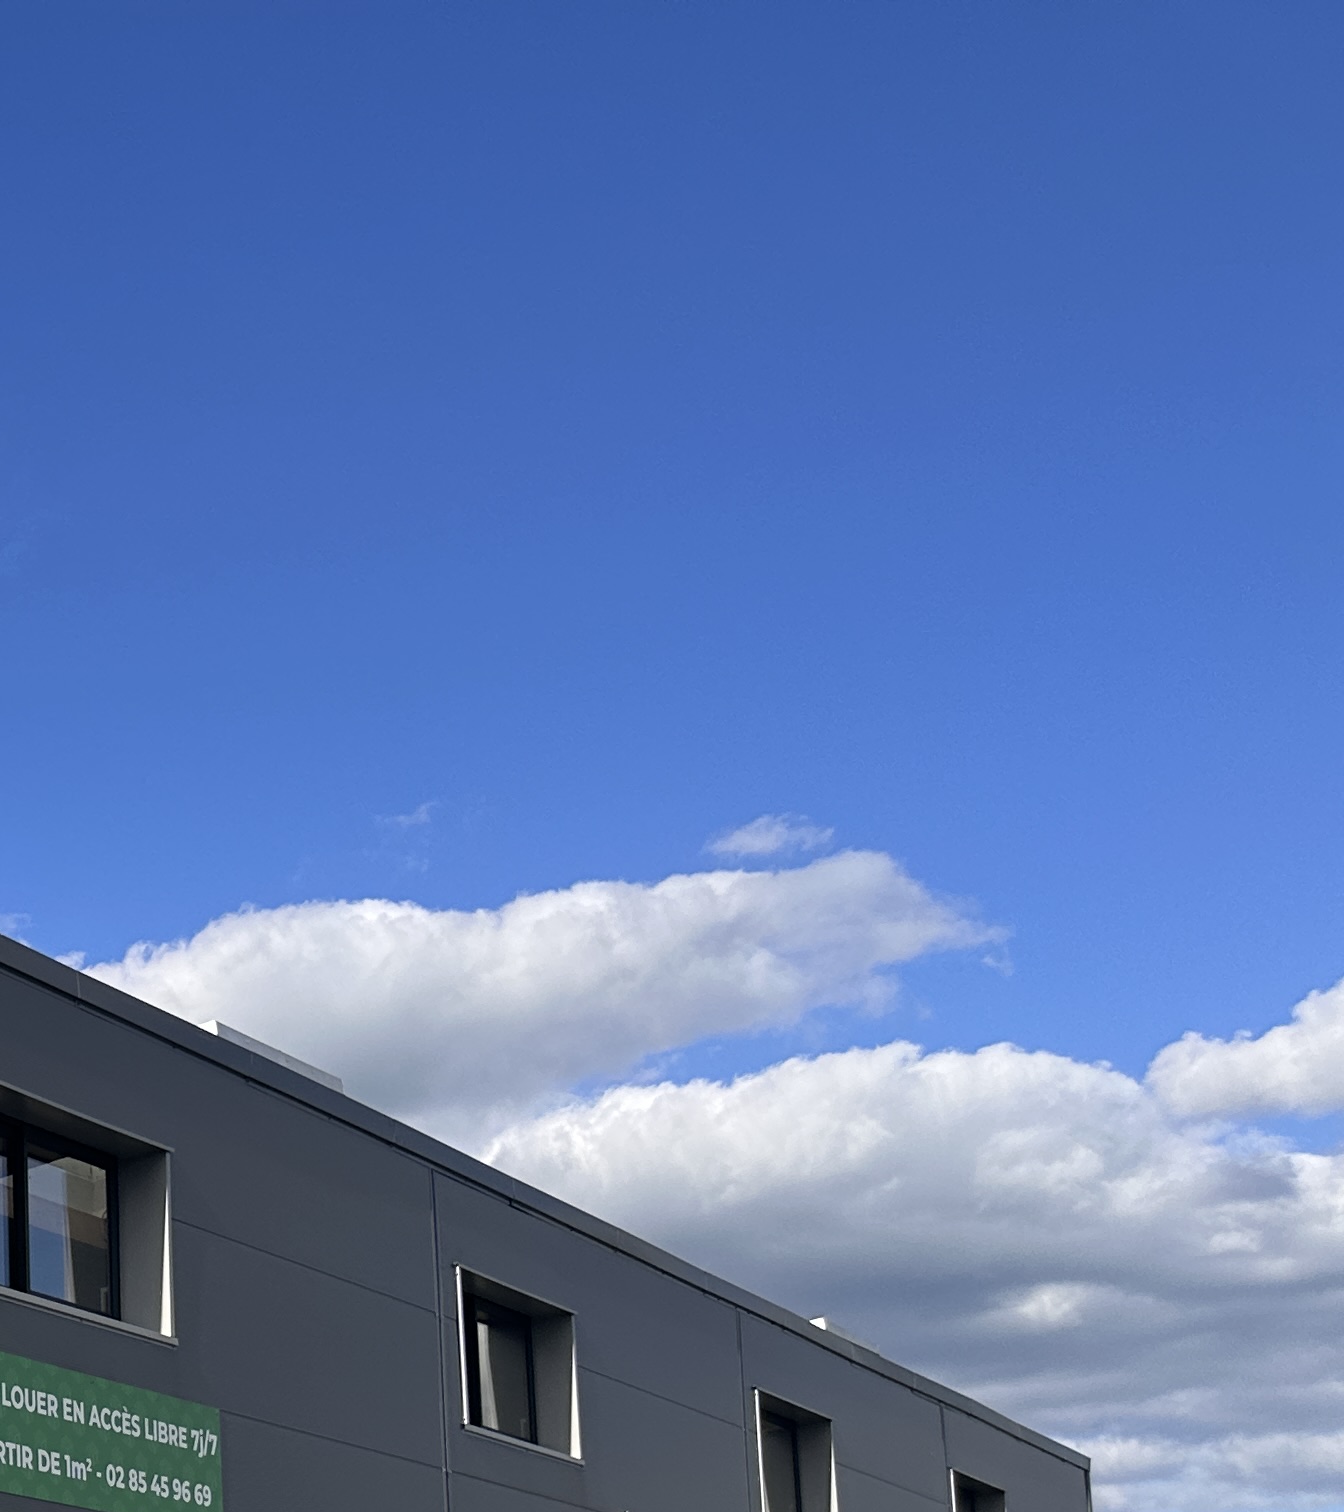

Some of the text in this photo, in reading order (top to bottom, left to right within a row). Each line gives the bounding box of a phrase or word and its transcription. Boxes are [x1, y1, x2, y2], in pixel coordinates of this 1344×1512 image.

[2, 1382, 58, 1418] LOUER
[63, 1398, 84, 1424] EN
[89, 1406, 141, 1437] ACCÈS
[145, 1417, 187, 1448] LIBRE
[190, 1429, 217, 1457] 7j/7
[38, 1449, 61, 1475] DE
[106, 1464, 125, 1489] 02
[129, 1469, 147, 1493] 85
[150, 1475, 169, 1498] 45
[173, 1479, 191, 1502] 96
[194, 1483, 212, 1507] 69
